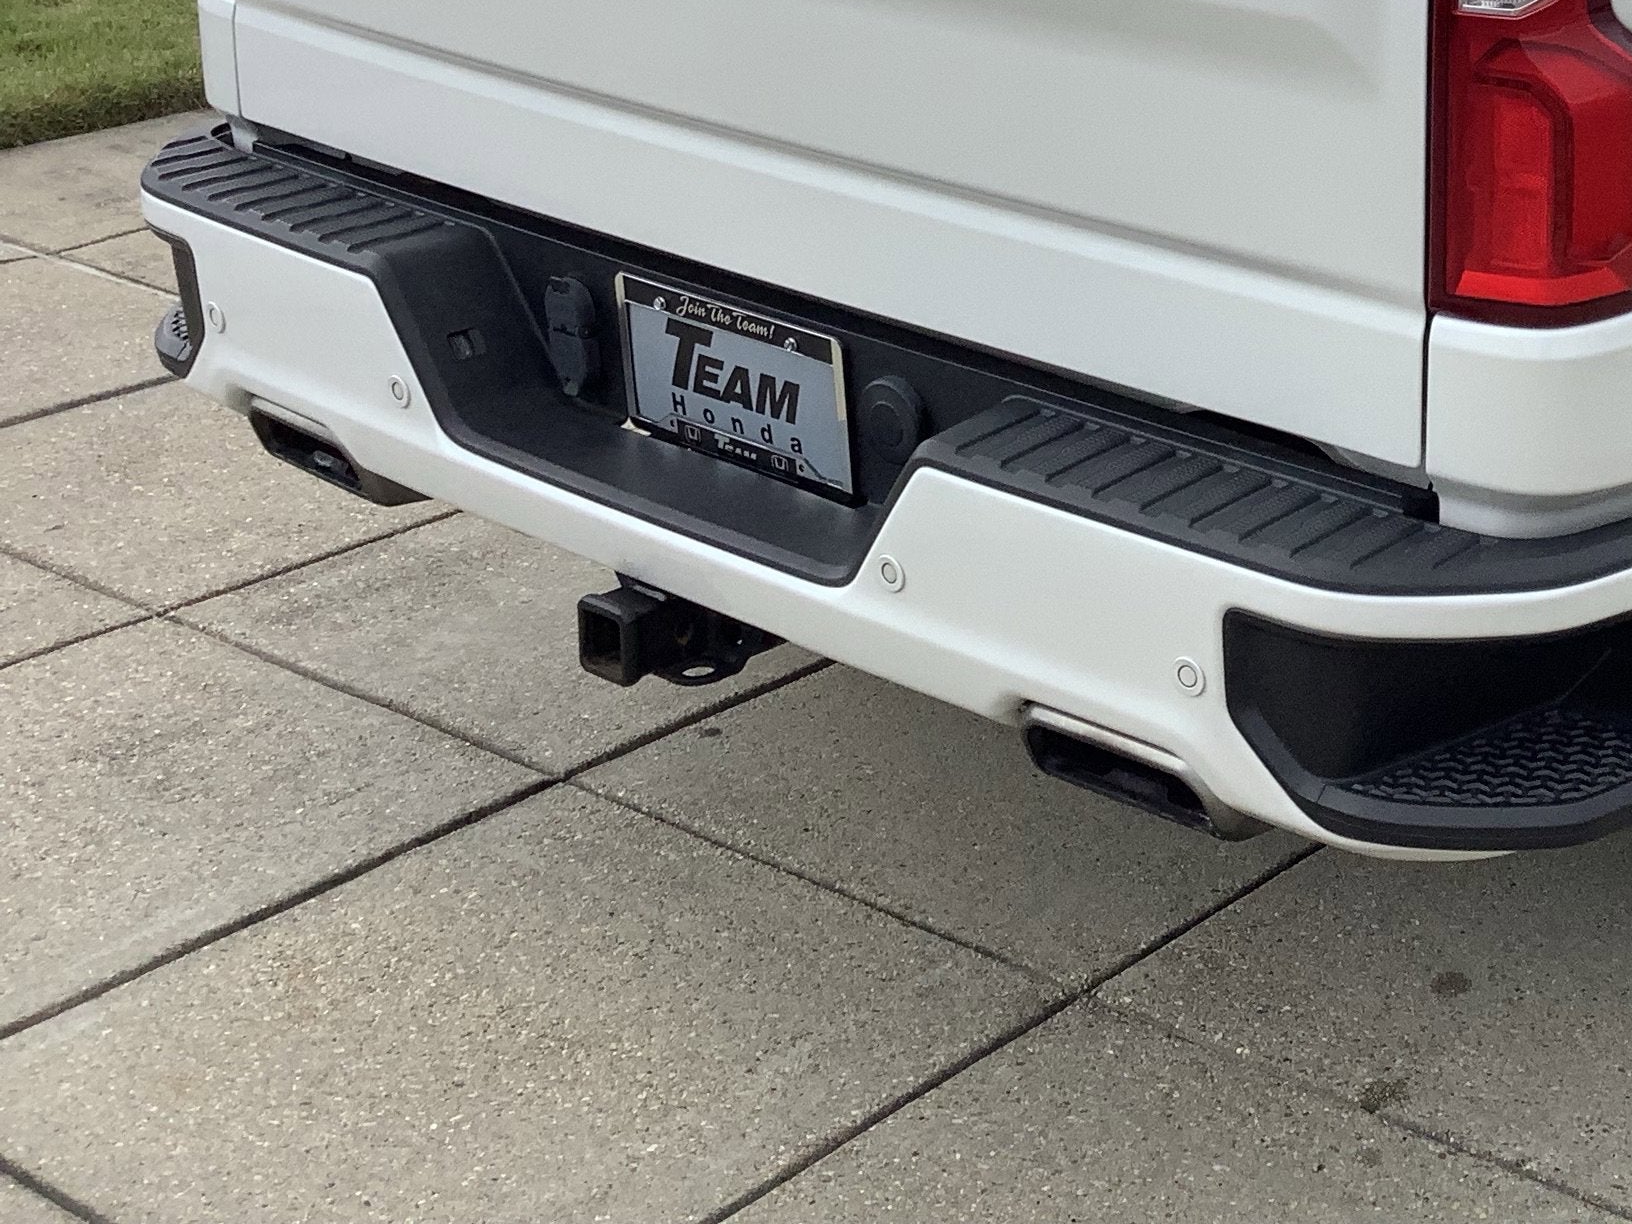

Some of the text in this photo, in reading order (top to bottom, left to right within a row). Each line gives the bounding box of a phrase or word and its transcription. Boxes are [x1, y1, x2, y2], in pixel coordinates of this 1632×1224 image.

[675, 295, 776, 339] Join The Team!
[665, 317, 800, 425] TEAM
[671, 392, 803, 455] Honda
[713, 433, 758, 461] TEAM
